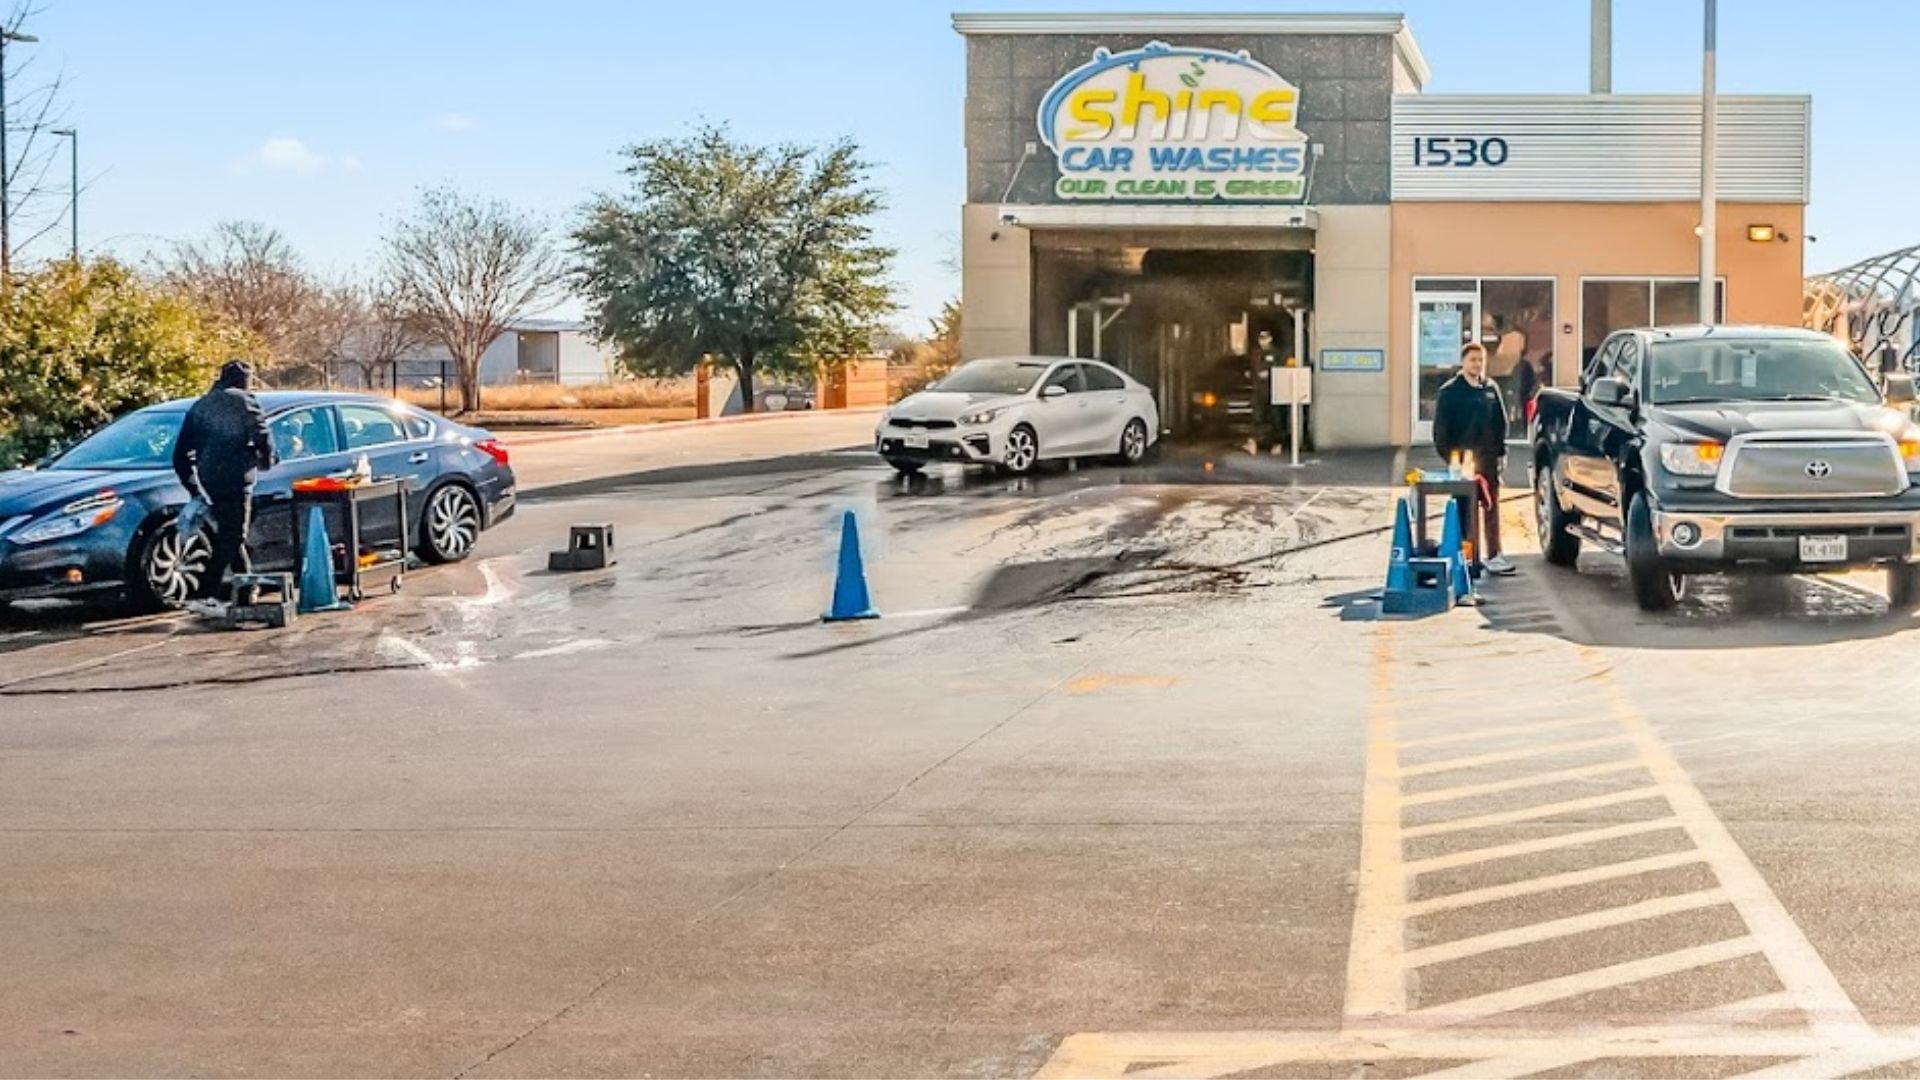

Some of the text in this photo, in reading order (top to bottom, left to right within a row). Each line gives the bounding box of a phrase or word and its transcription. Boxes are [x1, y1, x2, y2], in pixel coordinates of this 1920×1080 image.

[1064, 71, 1301, 141] shine
[1062, 147, 1301, 172] CAR WASHES
[1414, 136, 1508, 166] 1530
[1059, 179, 1302, 195] OUR CLEAN IS GREEN
